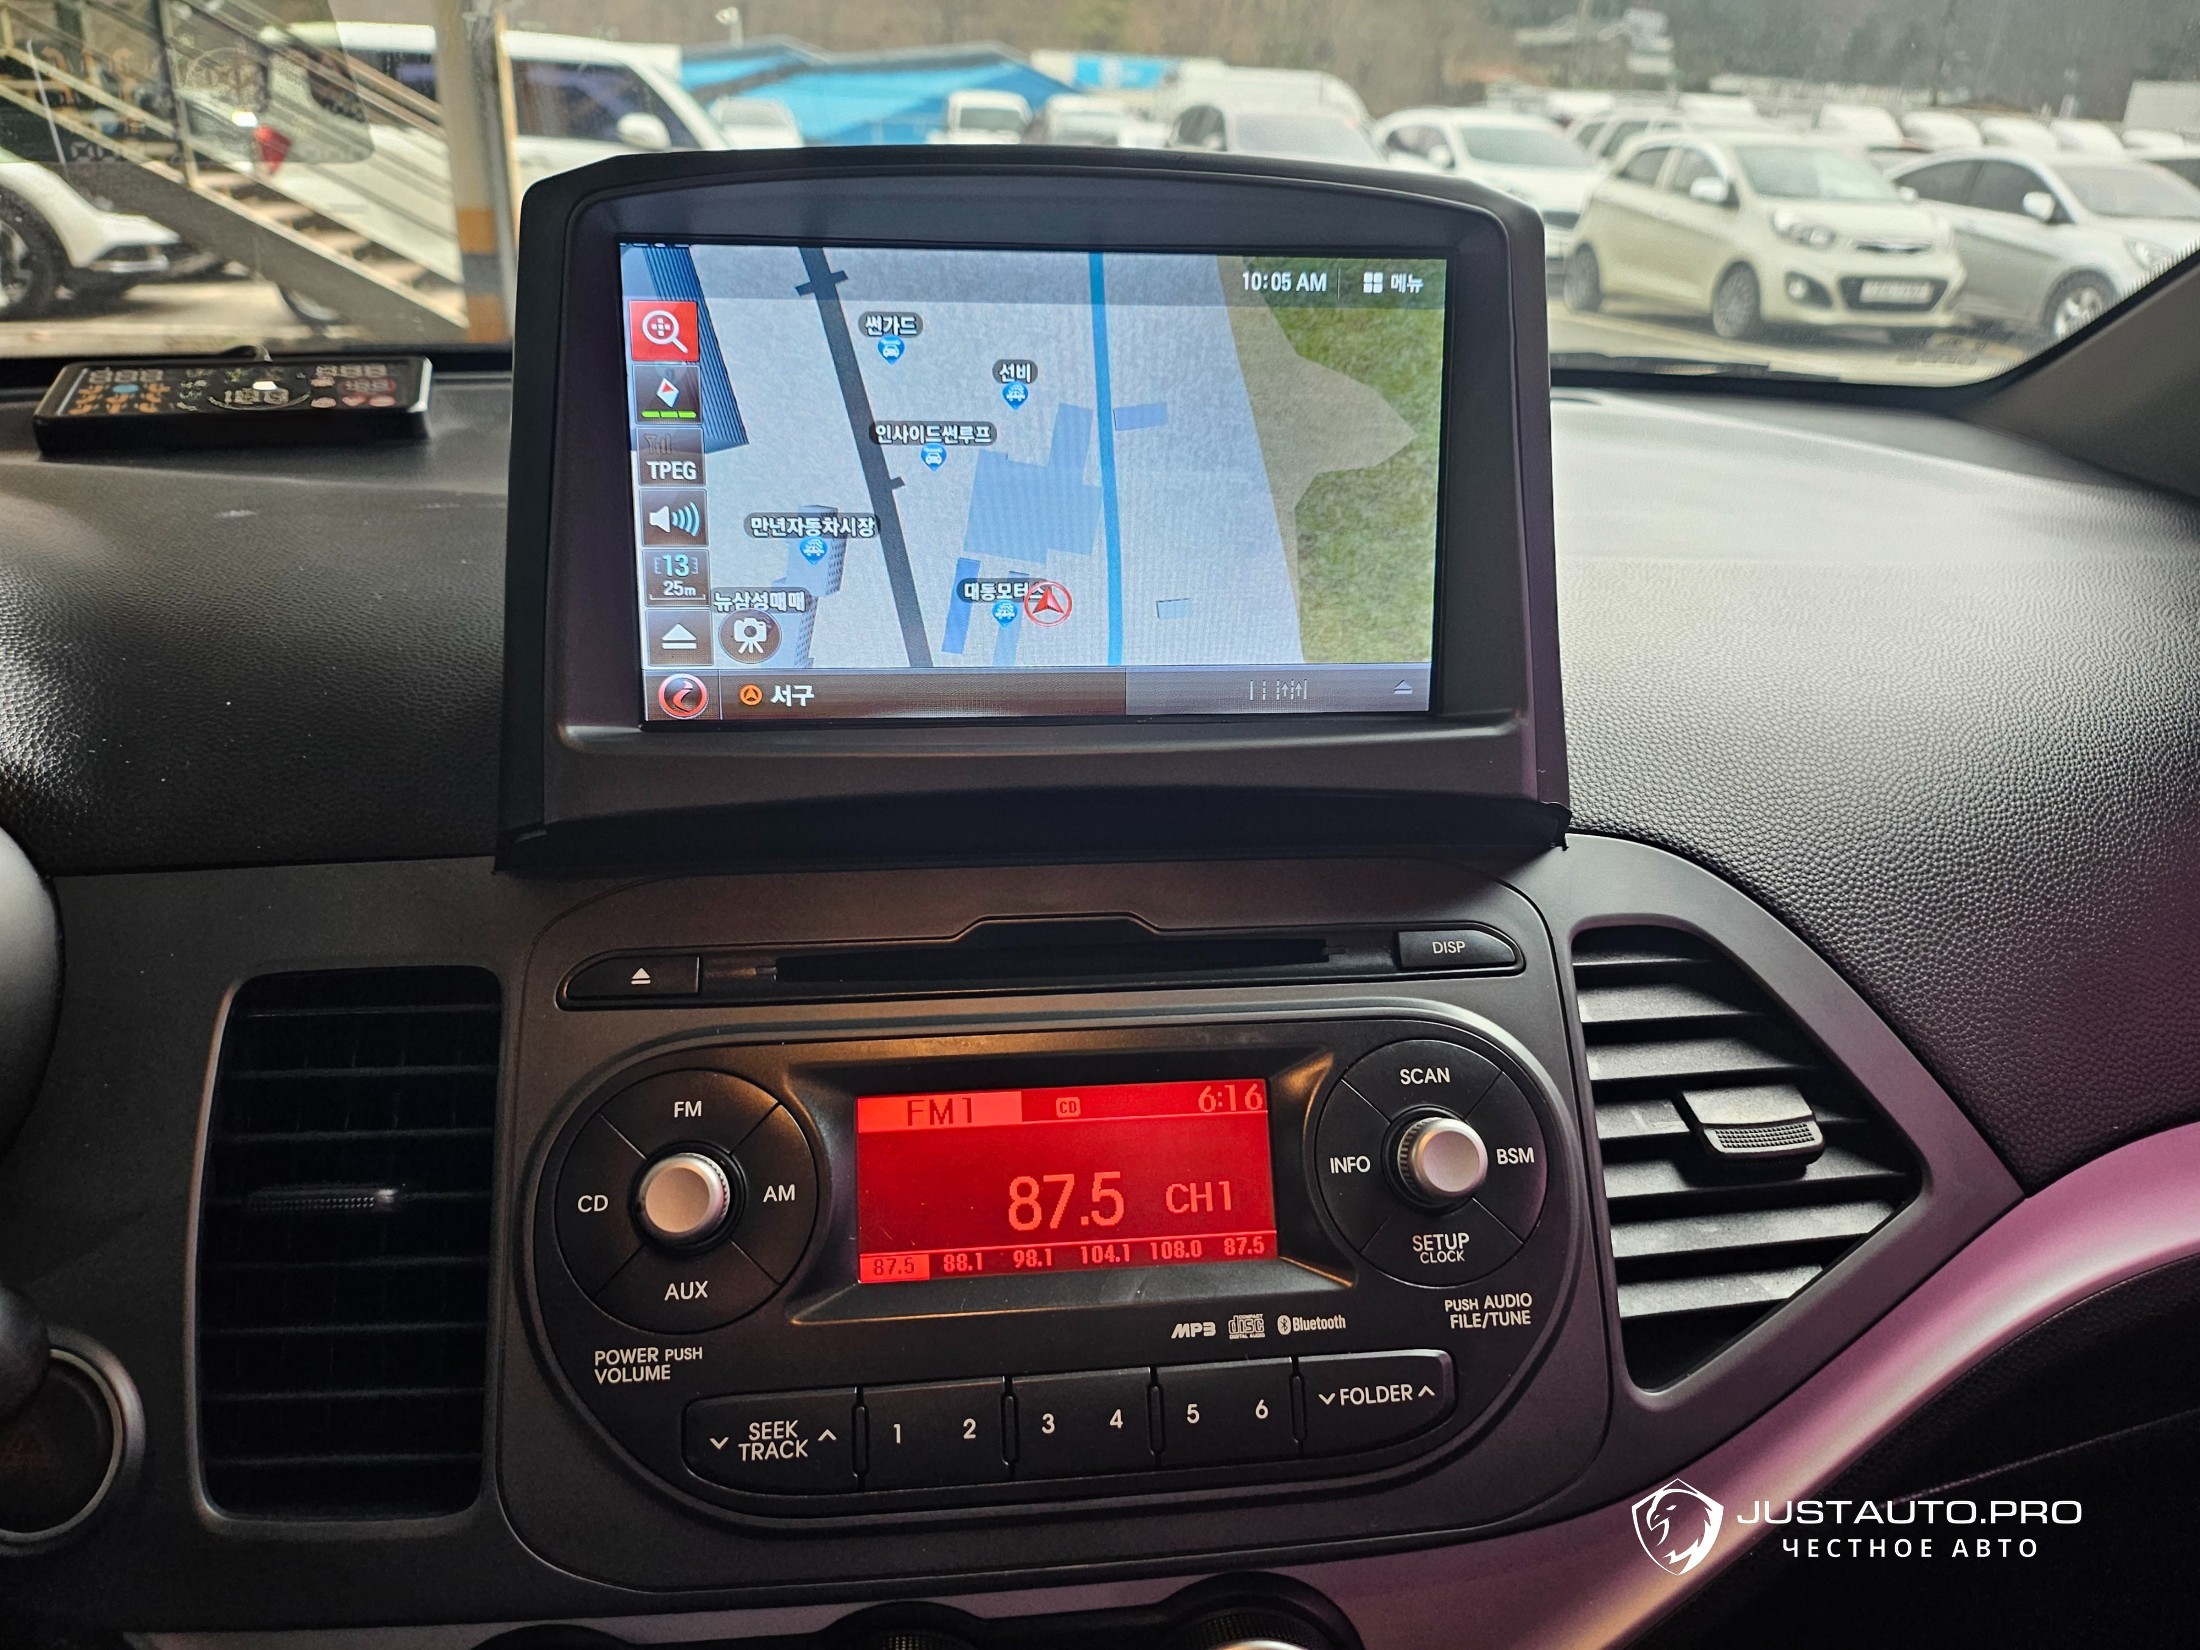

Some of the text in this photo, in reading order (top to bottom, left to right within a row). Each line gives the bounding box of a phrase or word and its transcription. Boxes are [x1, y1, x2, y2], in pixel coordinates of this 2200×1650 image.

[1242, 271, 1327, 292] 10:05 AM
[1390, 272, 1424, 293] 메뉴
[865, 315, 917, 336] 썬가드
[999, 363, 1031, 383] 선비
[875, 424, 992, 444] 인사이드썬루프
[646, 460, 697, 480] TPEG
[751, 516, 876, 537] 만년자동차시장
[662, 554, 690, 577] 13
[663, 580, 697, 597] 25m
[713, 590, 806, 612] 뉴삼성매매
[770, 684, 815, 707] 서구
[1432, 940, 1466, 955] DISP
[1399, 1067, 1451, 1085] SCAN
[1058, 1099, 1078, 1115] CD
[1198, 1083, 1263, 1113] 6:16
[673, 1100, 703, 1118] FM
[906, 1097, 974, 1127] FM1
[1329, 1155, 1371, 1174] INFO
[1496, 1147, 1535, 1165] BSM
[577, 1194, 609, 1213] CD
[762, 1184, 796, 1203] AM
[1008, 1171, 1233, 1232] 87.5 CH1
[1412, 1232, 1470, 1253] SETUP
[872, 1236, 1266, 1276] 87.5 88.1 98.1 104.1 108.0 87.5
[1420, 1249, 1465, 1264] CLOCK
[664, 1280, 708, 1301] AUX
[1444, 1292, 1532, 1312] PUSH AUDIO
[1293, 1314, 1346, 1332] Bluetooth
[1450, 1309, 1531, 1329] FILE/TUNE
[1171, 1321, 1217, 1339] MP3
[594, 1346, 703, 1366] POWER PUSH
[594, 1364, 671, 1384] VOLUME
[1340, 1384, 1413, 1406] FOLDER
[1109, 1408, 1124, 1429] 4
[1186, 1403, 1200, 1424] 5
[1255, 1399, 1269, 1420] 6
[748, 1419, 799, 1441] SEEK
[893, 1423, 902, 1445] 1
[962, 1418, 977, 1440] 2
[1041, 1413, 1056, 1434] 3
[738, 1438, 809, 1462] TRACK
